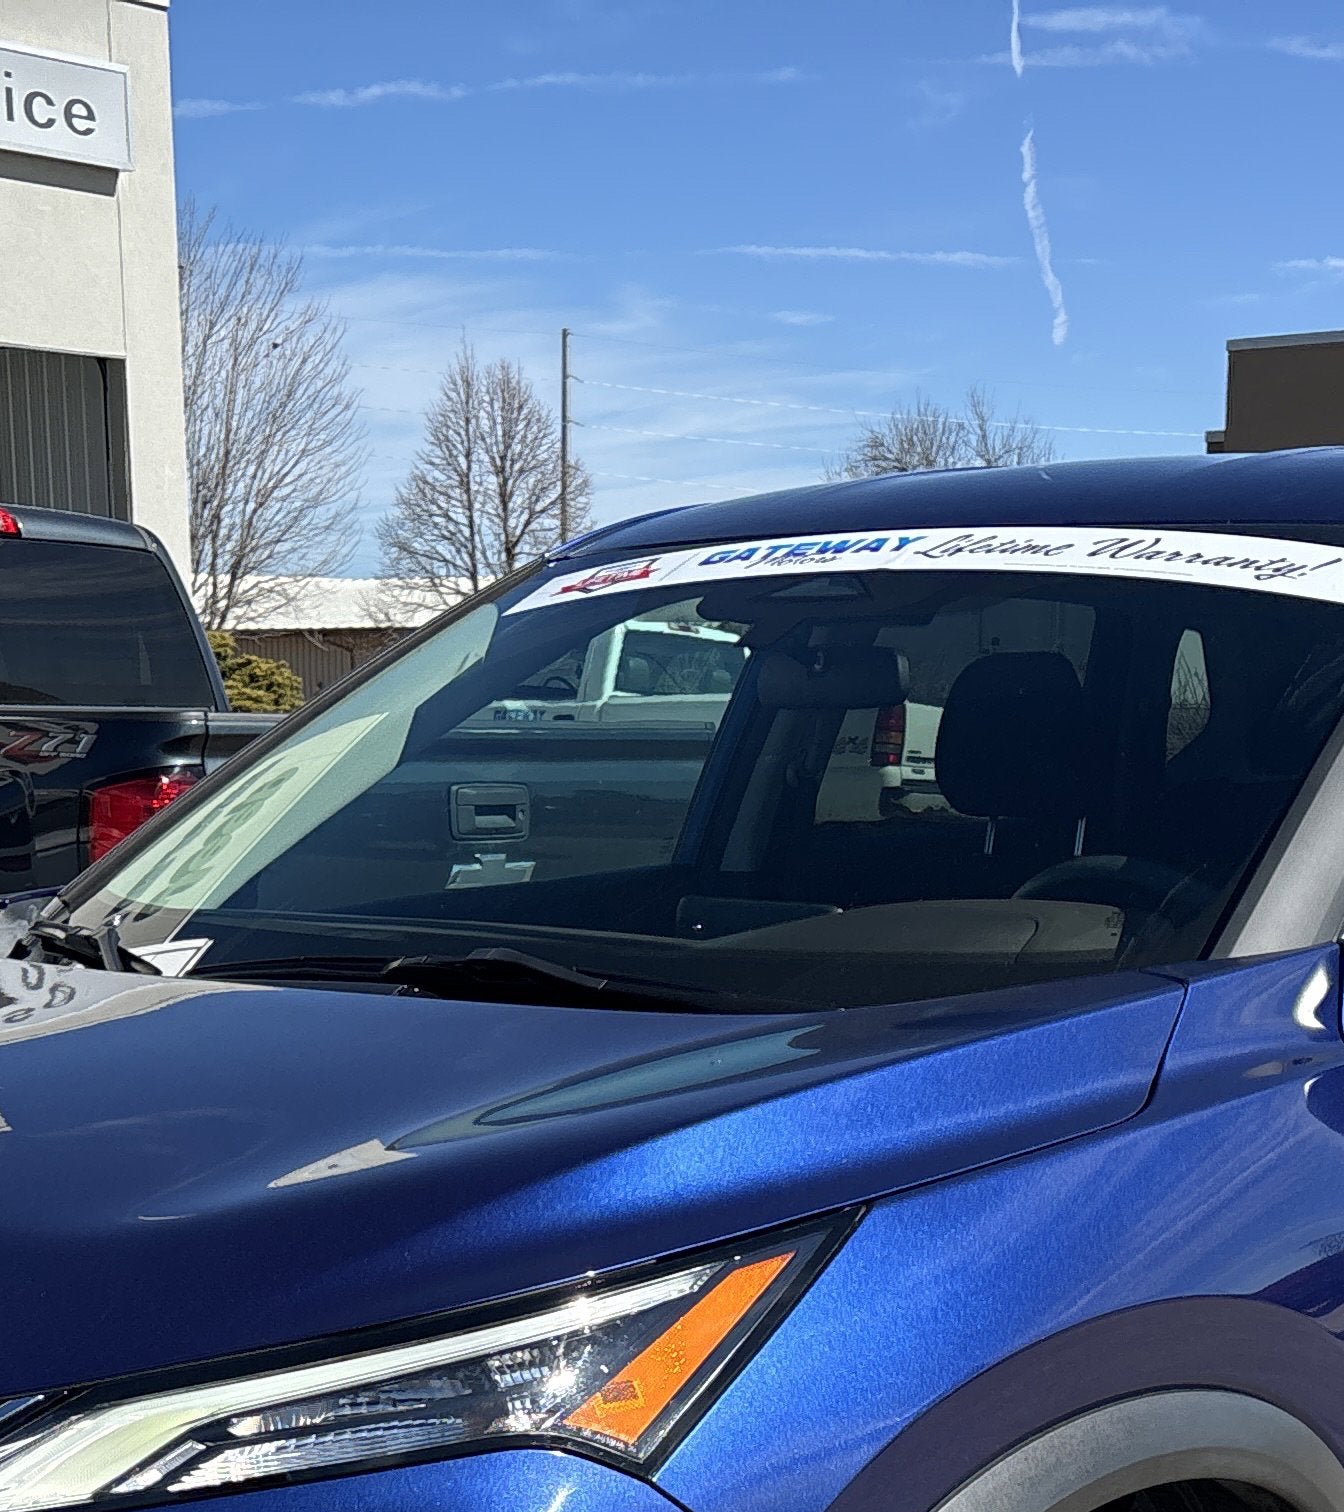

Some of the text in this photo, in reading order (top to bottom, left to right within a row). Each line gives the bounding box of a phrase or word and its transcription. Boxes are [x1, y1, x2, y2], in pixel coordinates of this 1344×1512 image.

[698, 536, 927, 566] GATEWAY
[914, 534, 1064, 558] Lifetime
[1086, 536, 1343, 582] Warranty!
[0, 730, 97, 757] Z71
